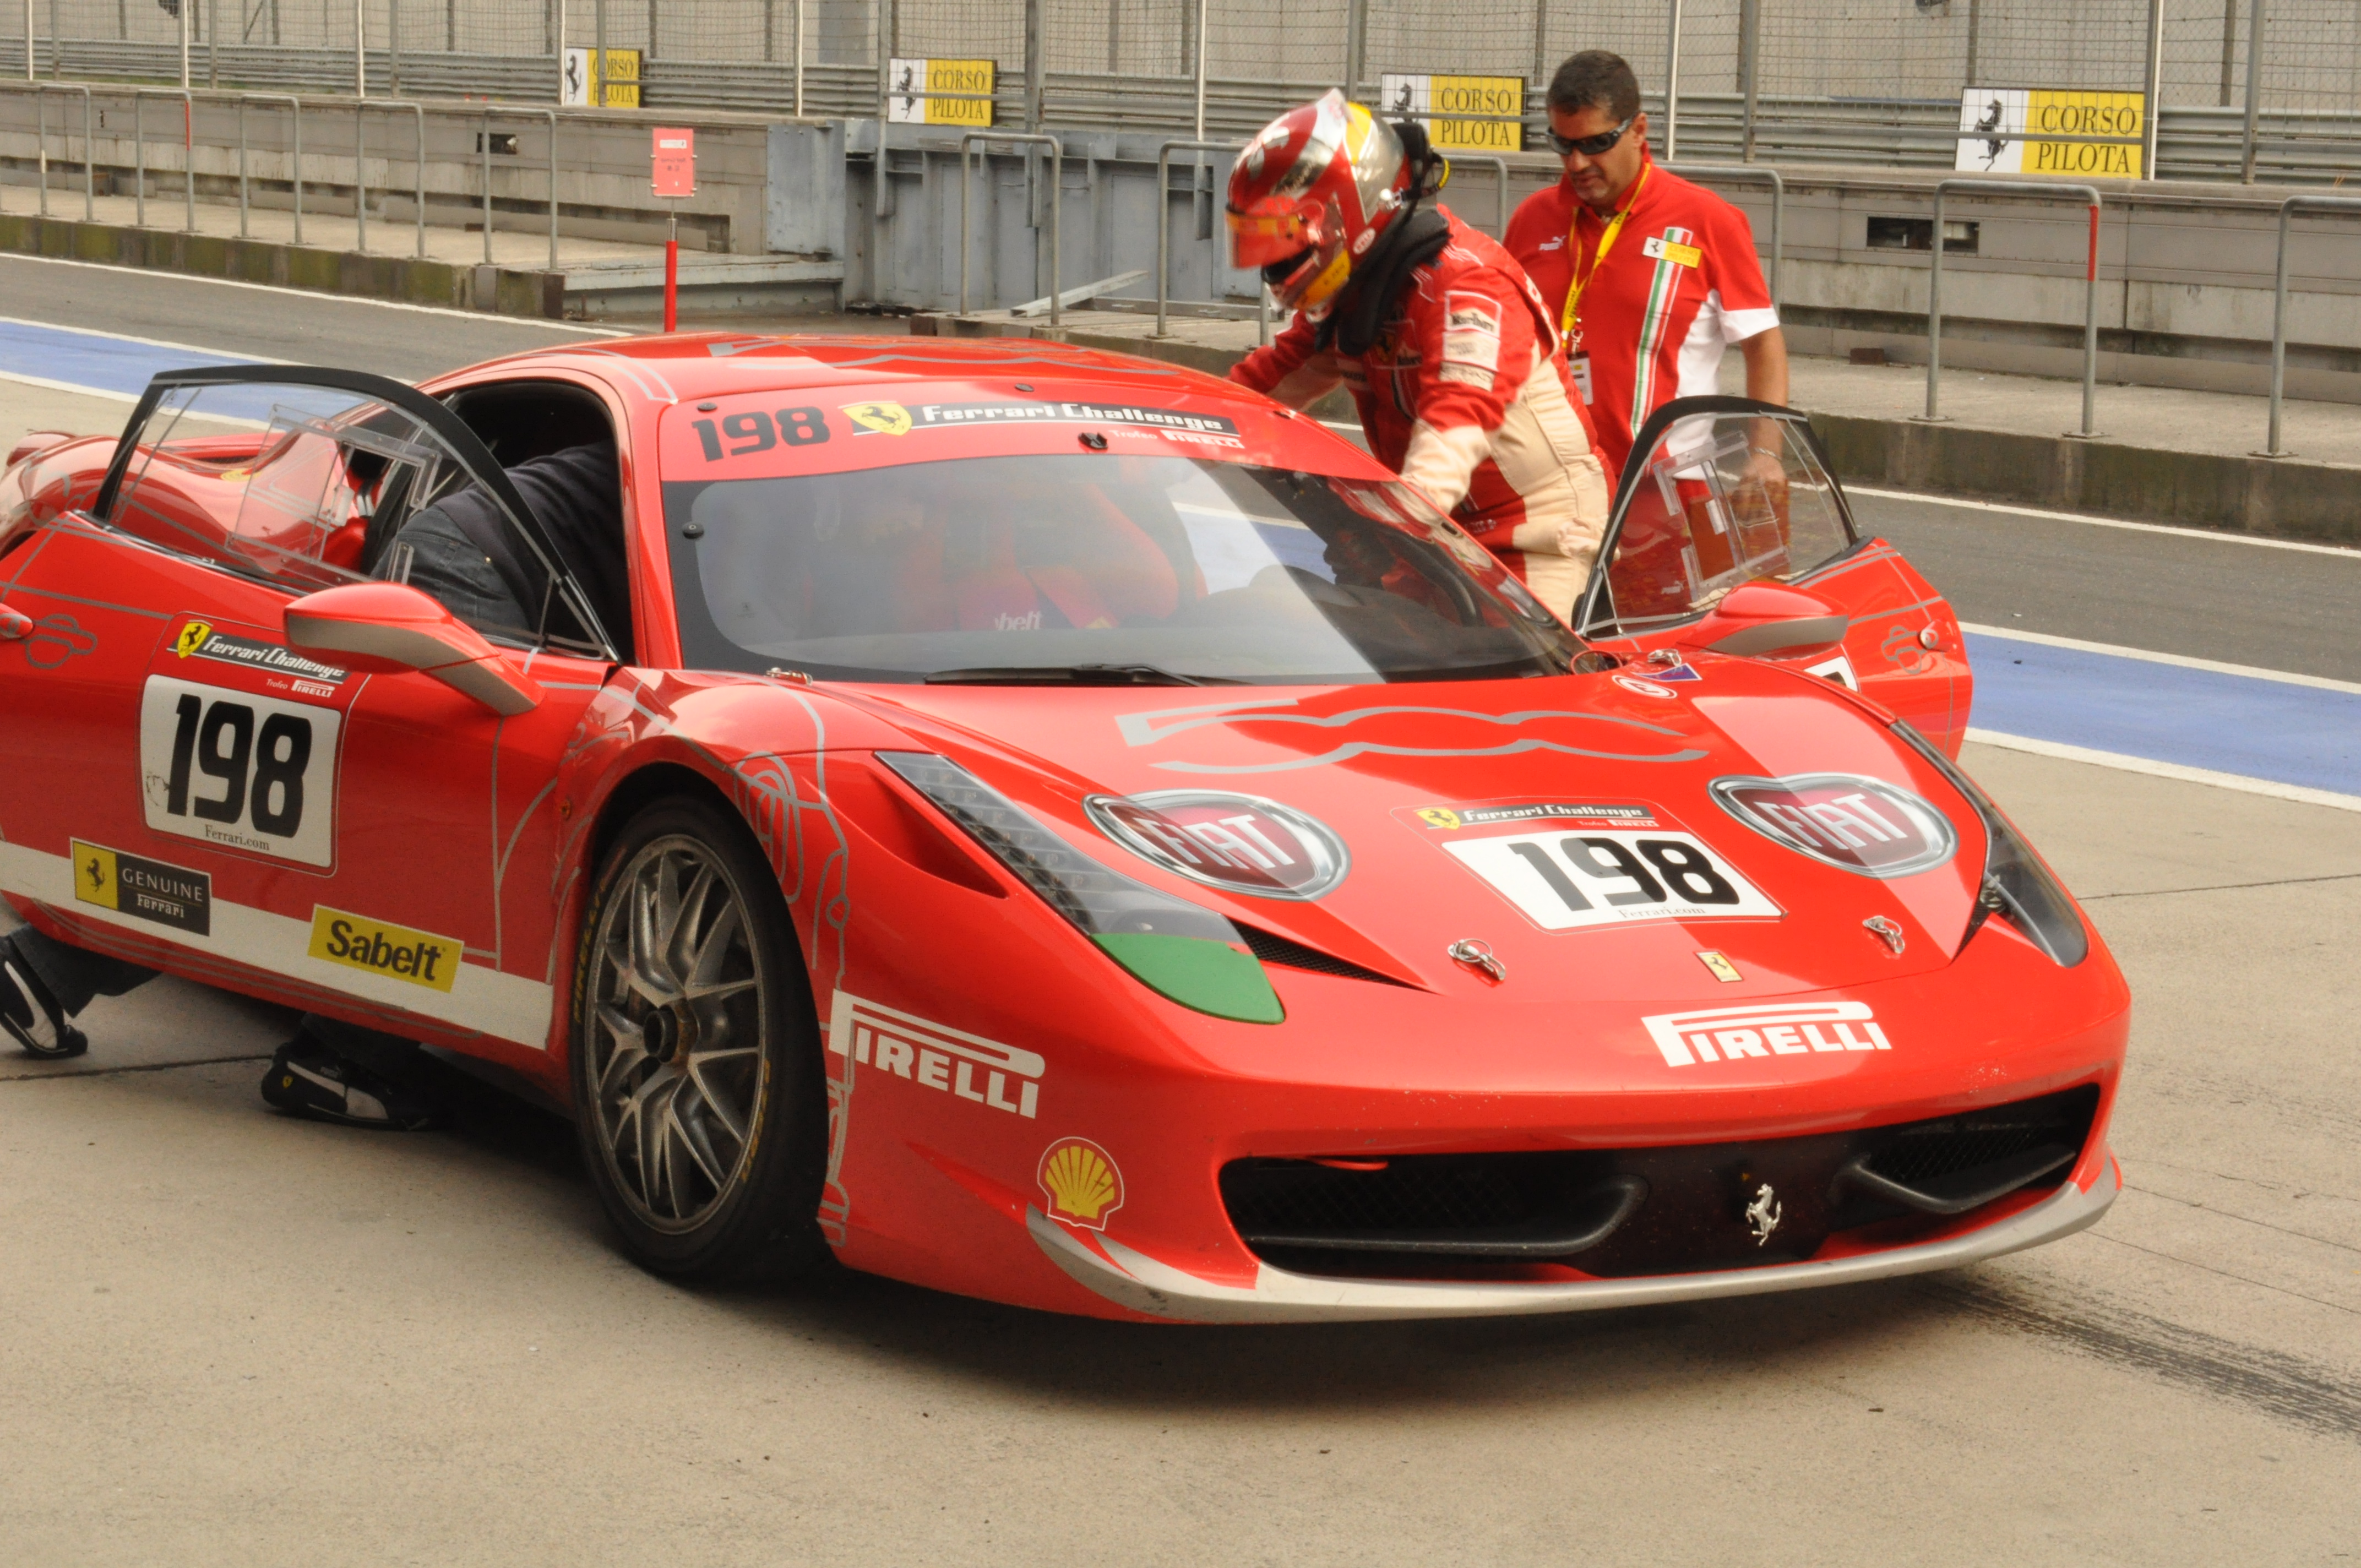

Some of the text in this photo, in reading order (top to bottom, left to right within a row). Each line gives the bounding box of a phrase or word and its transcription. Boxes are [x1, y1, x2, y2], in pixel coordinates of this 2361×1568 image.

[933, 70, 985, 91] CORSO
[932, 98, 984, 117] PILOTA
[1441, 88, 1512, 113] CORSO
[1440, 120, 1511, 146] PILOTA
[2041, 105, 2136, 134] CORSO
[2035, 143, 2131, 173] PILOTA
[922, 403, 1223, 430] Ferrari Challenge
[692, 406, 830, 462] 198
[1108, 429, 1245, 449] Trofeo PIRELLI
[203, 635, 345, 678] Ferrari Challenge
[266, 678, 335, 698] Trofeo PIRELLI
[167, 694, 312, 838] 198
[1464, 804, 1643, 821] Ferrari Challenge
[1754, 793, 1908, 850] FIAT
[204, 824, 270, 851] Ferrari.com
[1132, 814, 1296, 869] FIAT
[122, 868, 203, 902] GENUINE
[1506, 837, 1740, 912] 198
[137, 893, 184, 918] Ferrari
[1618, 906, 1706, 919] Ferrari.com
[327, 919, 441, 981] Sabelt
[1641, 1001, 1892, 1067] PIRELLI
[828, 988, 1046, 1119] PIRELLI
